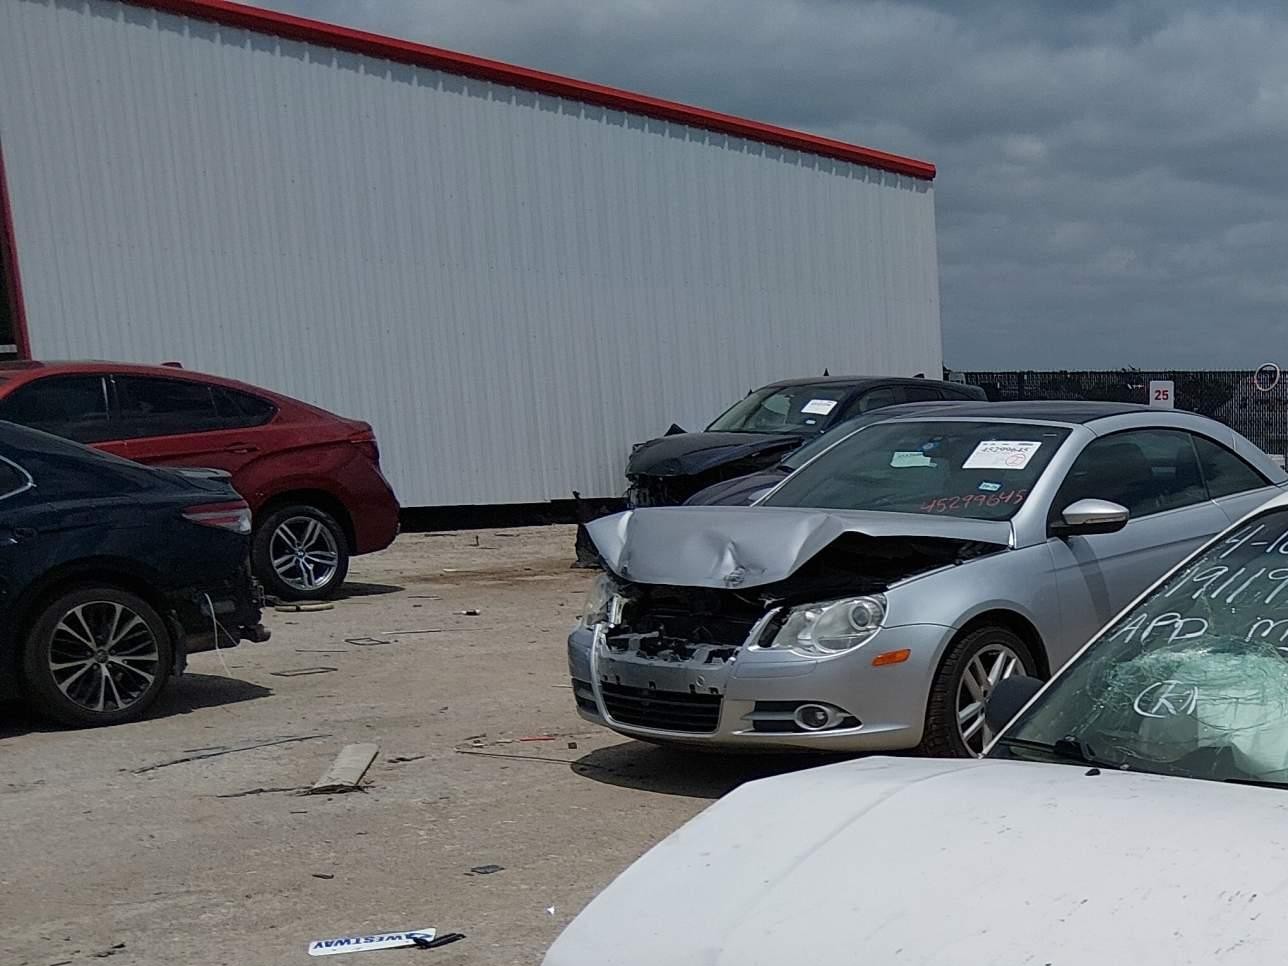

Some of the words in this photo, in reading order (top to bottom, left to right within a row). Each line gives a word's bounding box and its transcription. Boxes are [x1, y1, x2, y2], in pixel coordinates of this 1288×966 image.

[1154, 389, 1169, 400] 25
[1109, 612, 1209, 644] APD
[314, 934, 401, 949] WESTWAY
